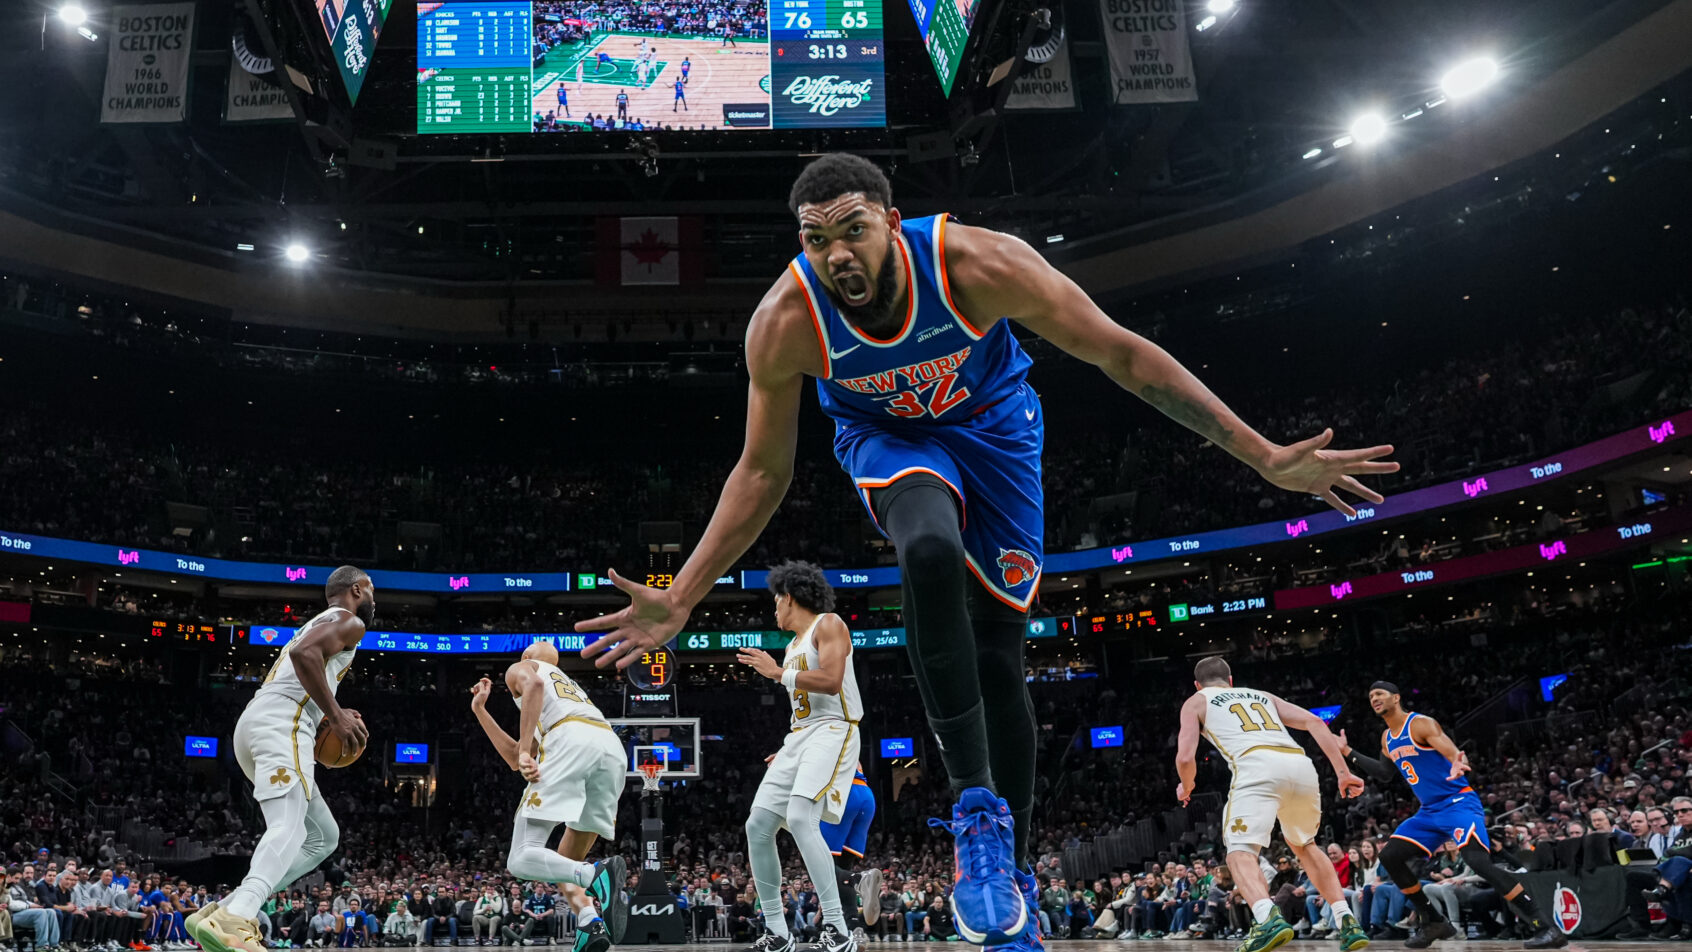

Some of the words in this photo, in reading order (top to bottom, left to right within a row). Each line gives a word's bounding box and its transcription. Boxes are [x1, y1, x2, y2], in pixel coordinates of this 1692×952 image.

[1108, 0, 1177, 14] BOSTON
[119, 15, 188, 33] BOSTON
[784, 12, 812, 28] 76
[841, 12, 868, 28] 65
[1113, 15, 1177, 33] CELTICS
[120, 34, 182, 51] CELTICS
[809, 45, 847, 59] 3:13
[861, 46, 877, 55] 3rd
[1135, 50, 1160, 62] 1957
[134, 68, 162, 80] 1966
[1130, 64, 1174, 76] WORLD
[125, 82, 168, 95] WORLD
[782, 75, 873, 104] Different
[1012, 80, 1068, 95] AMPIONS
[1118, 77, 1192, 91] CHAMPIONS
[108, 96, 181, 110] CHAMPIONS
[233, 94, 289, 107] CHAMPIO
[808, 94, 862, 116] Here
[834, 370, 897, 394] NEW
[898, 346, 972, 386] YORK
[872, 372, 972, 419] 32
[1648, 420, 1676, 444] lyft
[1530, 467, 1544, 478] To
[1544, 462, 1562, 475] the
[1462, 476, 1488, 498] lyft
[1357, 508, 1374, 519] the
[1286, 520, 1308, 538] lyft
[1618, 528, 1632, 538] To
[1632, 524, 1651, 536] the
[0, 536, 12, 546] To
[14, 539, 31, 549] the
[1169, 542, 1182, 551] To
[1182, 540, 1199, 550] the
[1112, 546, 1133, 562] lyft
[1539, 540, 1567, 560] lyft
[118, 550, 139, 565] lyft
[177, 559, 188, 569] To
[189, 562, 204, 571] the
[286, 567, 306, 581] lyft
[646, 574, 672, 587] 2:23
[715, 576, 734, 584] ank
[840, 574, 851, 582] To
[853, 575, 868, 583] the
[1401, 573, 1414, 583] To
[1415, 571, 1433, 581] the
[450, 576, 469, 590] lyft
[504, 578, 515, 586] To
[517, 578, 532, 586] the
[582, 577, 594, 586] TD
[1330, 581, 1353, 600] lyft
[1172, 608, 1186, 618] TD
[1191, 604, 1214, 615] Bank
[1223, 601, 1245, 612] 2:23
[1248, 598, 1265, 609] PM
[1117, 613, 1133, 623] 3:13
[152, 628, 162, 636] 65
[206, 633, 215, 641] 76
[178, 624, 194, 633] 3:13
[1093, 624, 1103, 632] 65
[558, 636, 585, 649] YORK
[688, 635, 708, 648] 65
[721, 634, 762, 648] BOSTON
[876, 636, 898, 645] 25/63
[641, 652, 666, 664] 3:13
[651, 664, 664, 685] 9
[794, 689, 811, 720] 3
[1210, 692, 1268, 707] PRITCHARD
[1229, 703, 1282, 732] 11
[1401, 761, 1419, 785] 3
[631, 904, 674, 915] KIA
